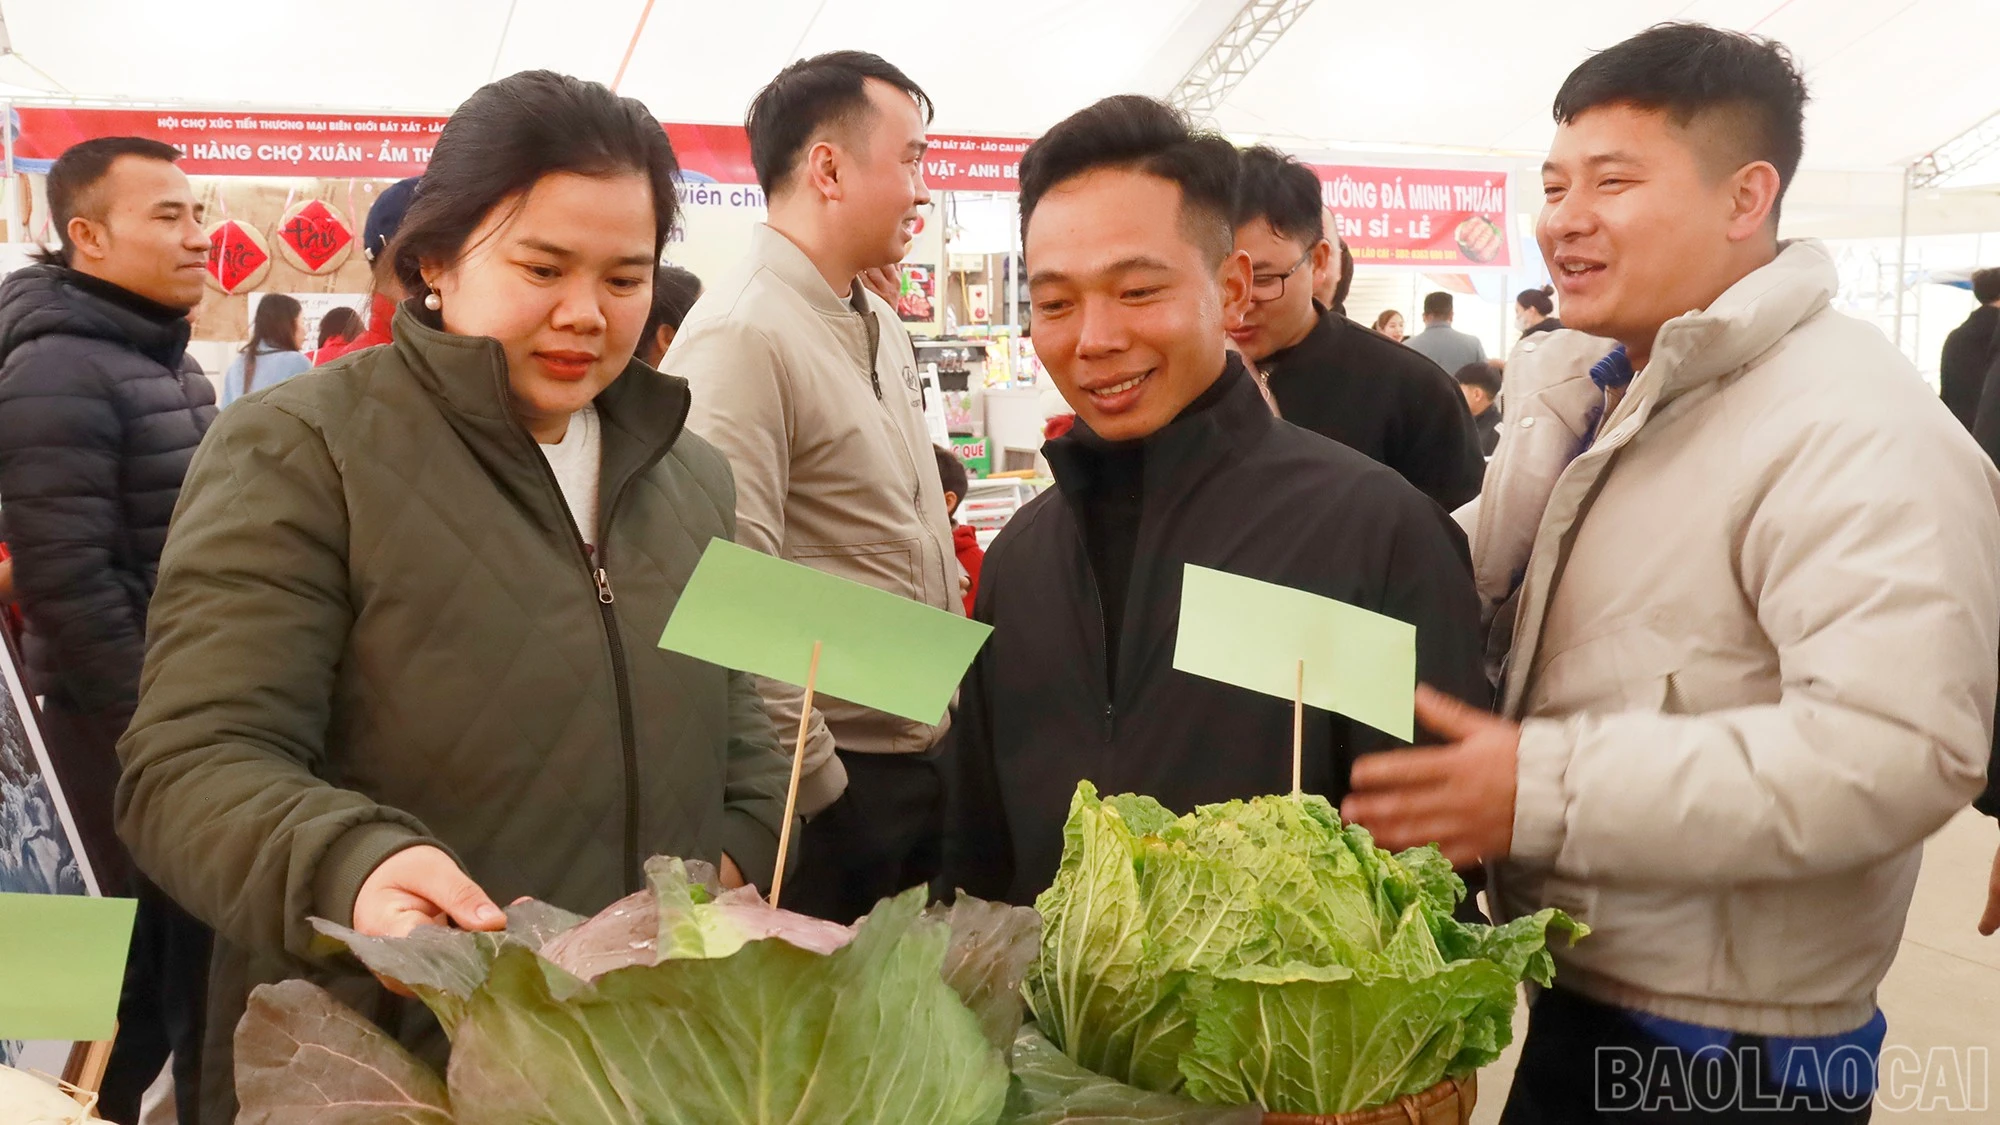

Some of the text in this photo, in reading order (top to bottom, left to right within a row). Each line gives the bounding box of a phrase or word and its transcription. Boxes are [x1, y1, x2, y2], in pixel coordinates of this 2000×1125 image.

[157, 116, 179, 130] HỘI
[180, 118, 207, 131] CHỢ
[209, 117, 233, 129] XÚC
[235, 117, 257, 130] TIẾN
[259, 119, 304, 131] THƯƠNG
[306, 121, 327, 132] MẠI
[328, 120, 352, 132] BIÊN
[353, 120, 378, 132] GIỚI
[379, 121, 399, 132] BÁT
[401, 122, 421, 133] XÁT
[192, 139, 252, 160] HÀNG
[256, 143, 303, 165] CHỢ
[307, 142, 362, 162] XUÂN
[377, 139, 408, 162] ẨM
[980, 142, 998, 151] LÀO
[999, 143, 1014, 152] CAI
[927, 160, 957, 180] VẶT
[967, 163, 1000, 178] ANH
[1381, 176, 1406, 210] ĐÁ
[1408, 184, 1452, 211] MINH
[1453, 180, 1504, 219] THUẬN
[1368, 213, 1389, 238] SỈ
[1408, 214, 1431, 238] LẺ
